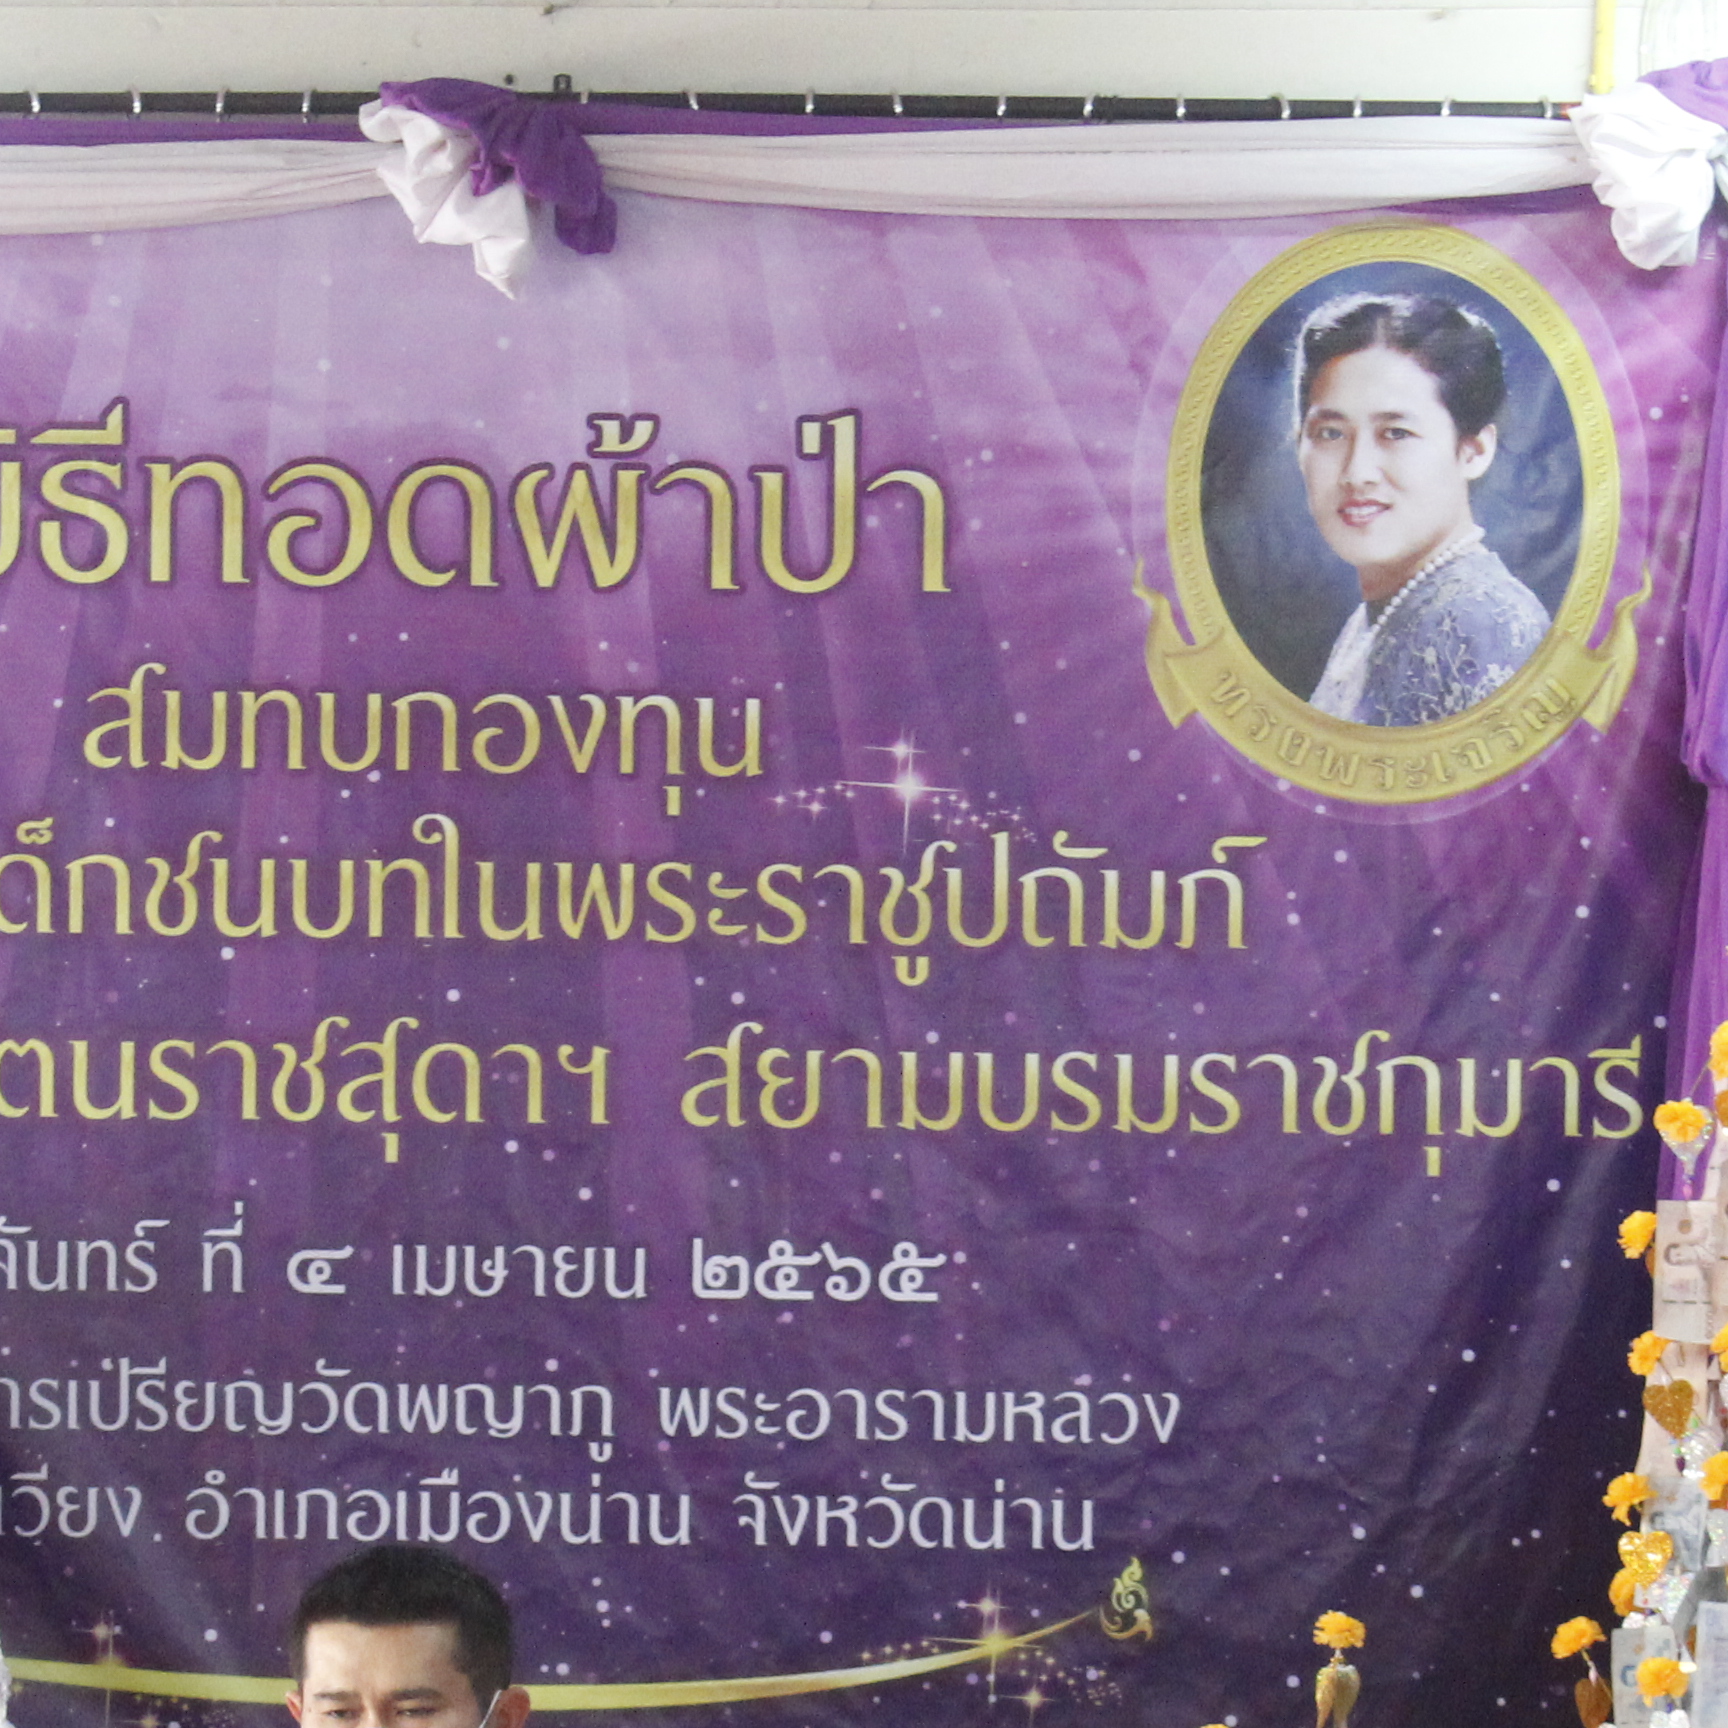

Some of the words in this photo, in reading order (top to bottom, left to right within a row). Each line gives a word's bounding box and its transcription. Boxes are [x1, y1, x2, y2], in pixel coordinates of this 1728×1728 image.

[83, 663, 764, 816] สมทบกองทุน
[680, 1022, 1643, 1178] สยามบรมราชกุมารี
[200, 1201, 245, 1294] ที่
[286, 1243, 356, 1294] ๔
[391, 1243, 648, 1299] เมษายน
[690, 1236, 948, 1303] ๒๕๖๕
[658, 1385, 1181, 1446] พระอารามหลวง
[184, 1466, 692, 1547] อำเภอเมืองน่าน
[732, 1469, 1095, 1552] จังหวัดน่าน
